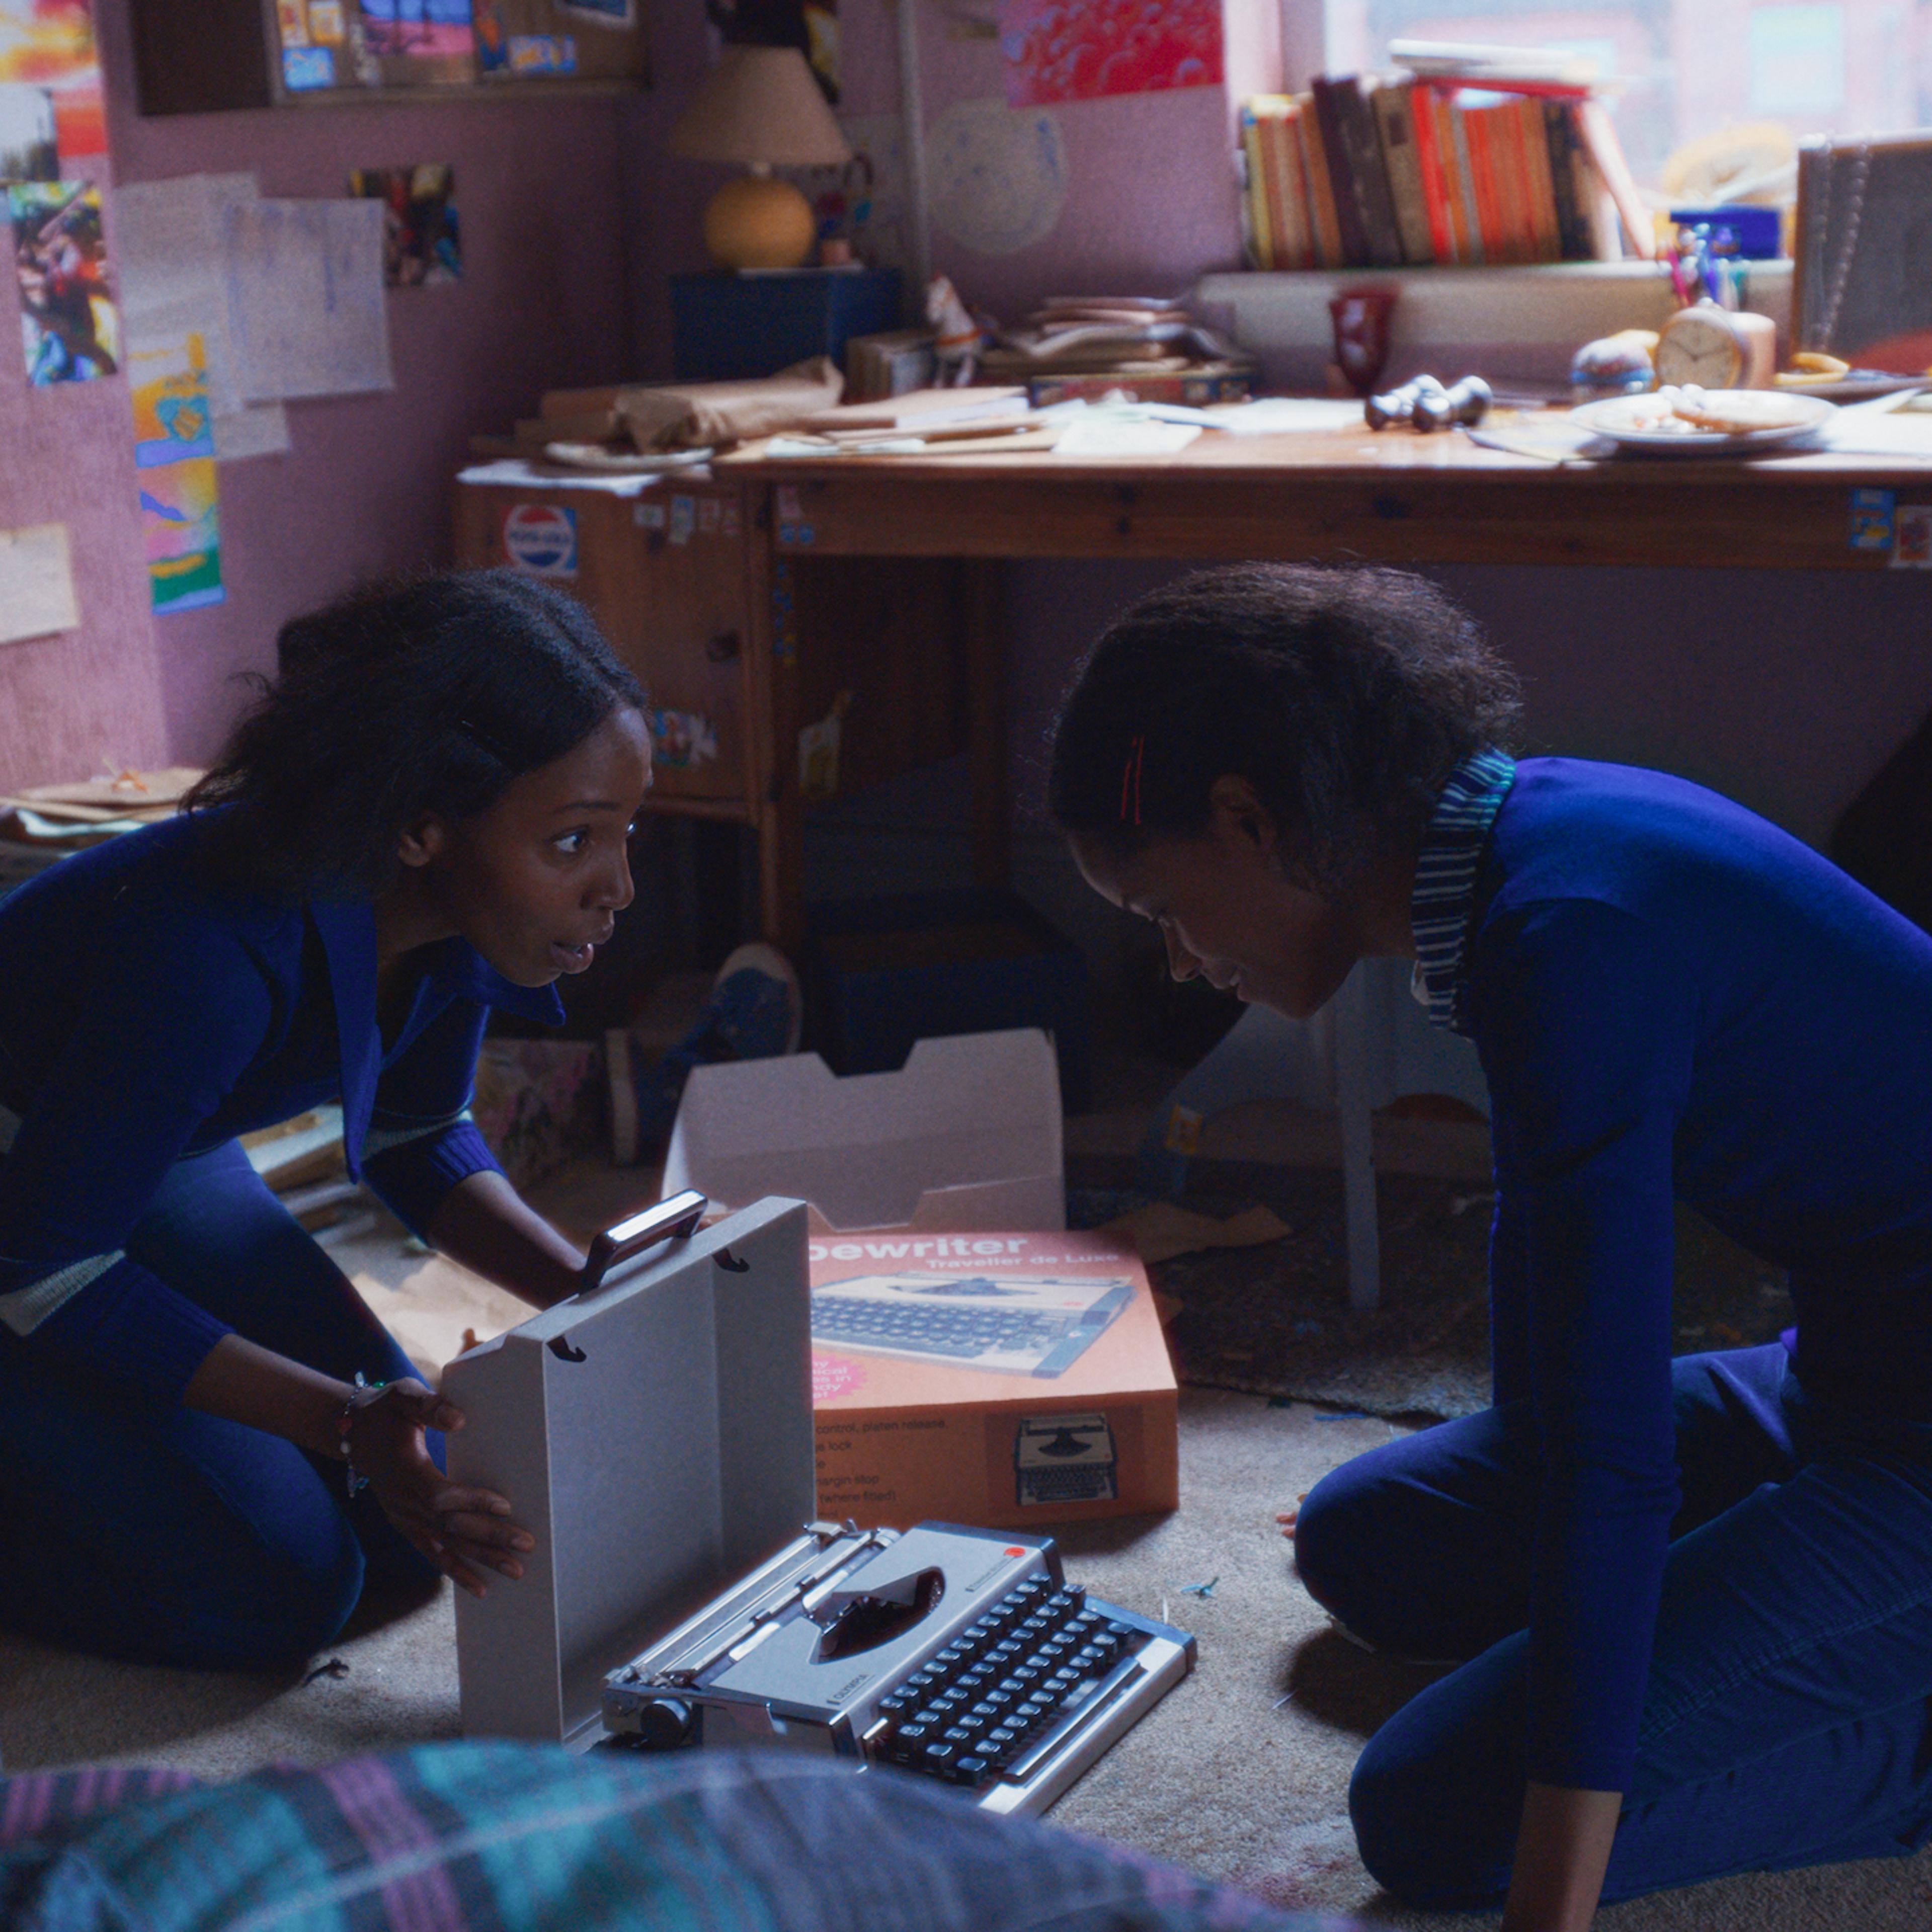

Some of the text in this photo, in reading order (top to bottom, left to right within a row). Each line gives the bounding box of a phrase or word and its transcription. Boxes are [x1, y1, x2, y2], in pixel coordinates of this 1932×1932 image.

[926, 1253, 1119, 1268] Traveller de Luxe
[855, 1474, 879, 1484] stop
